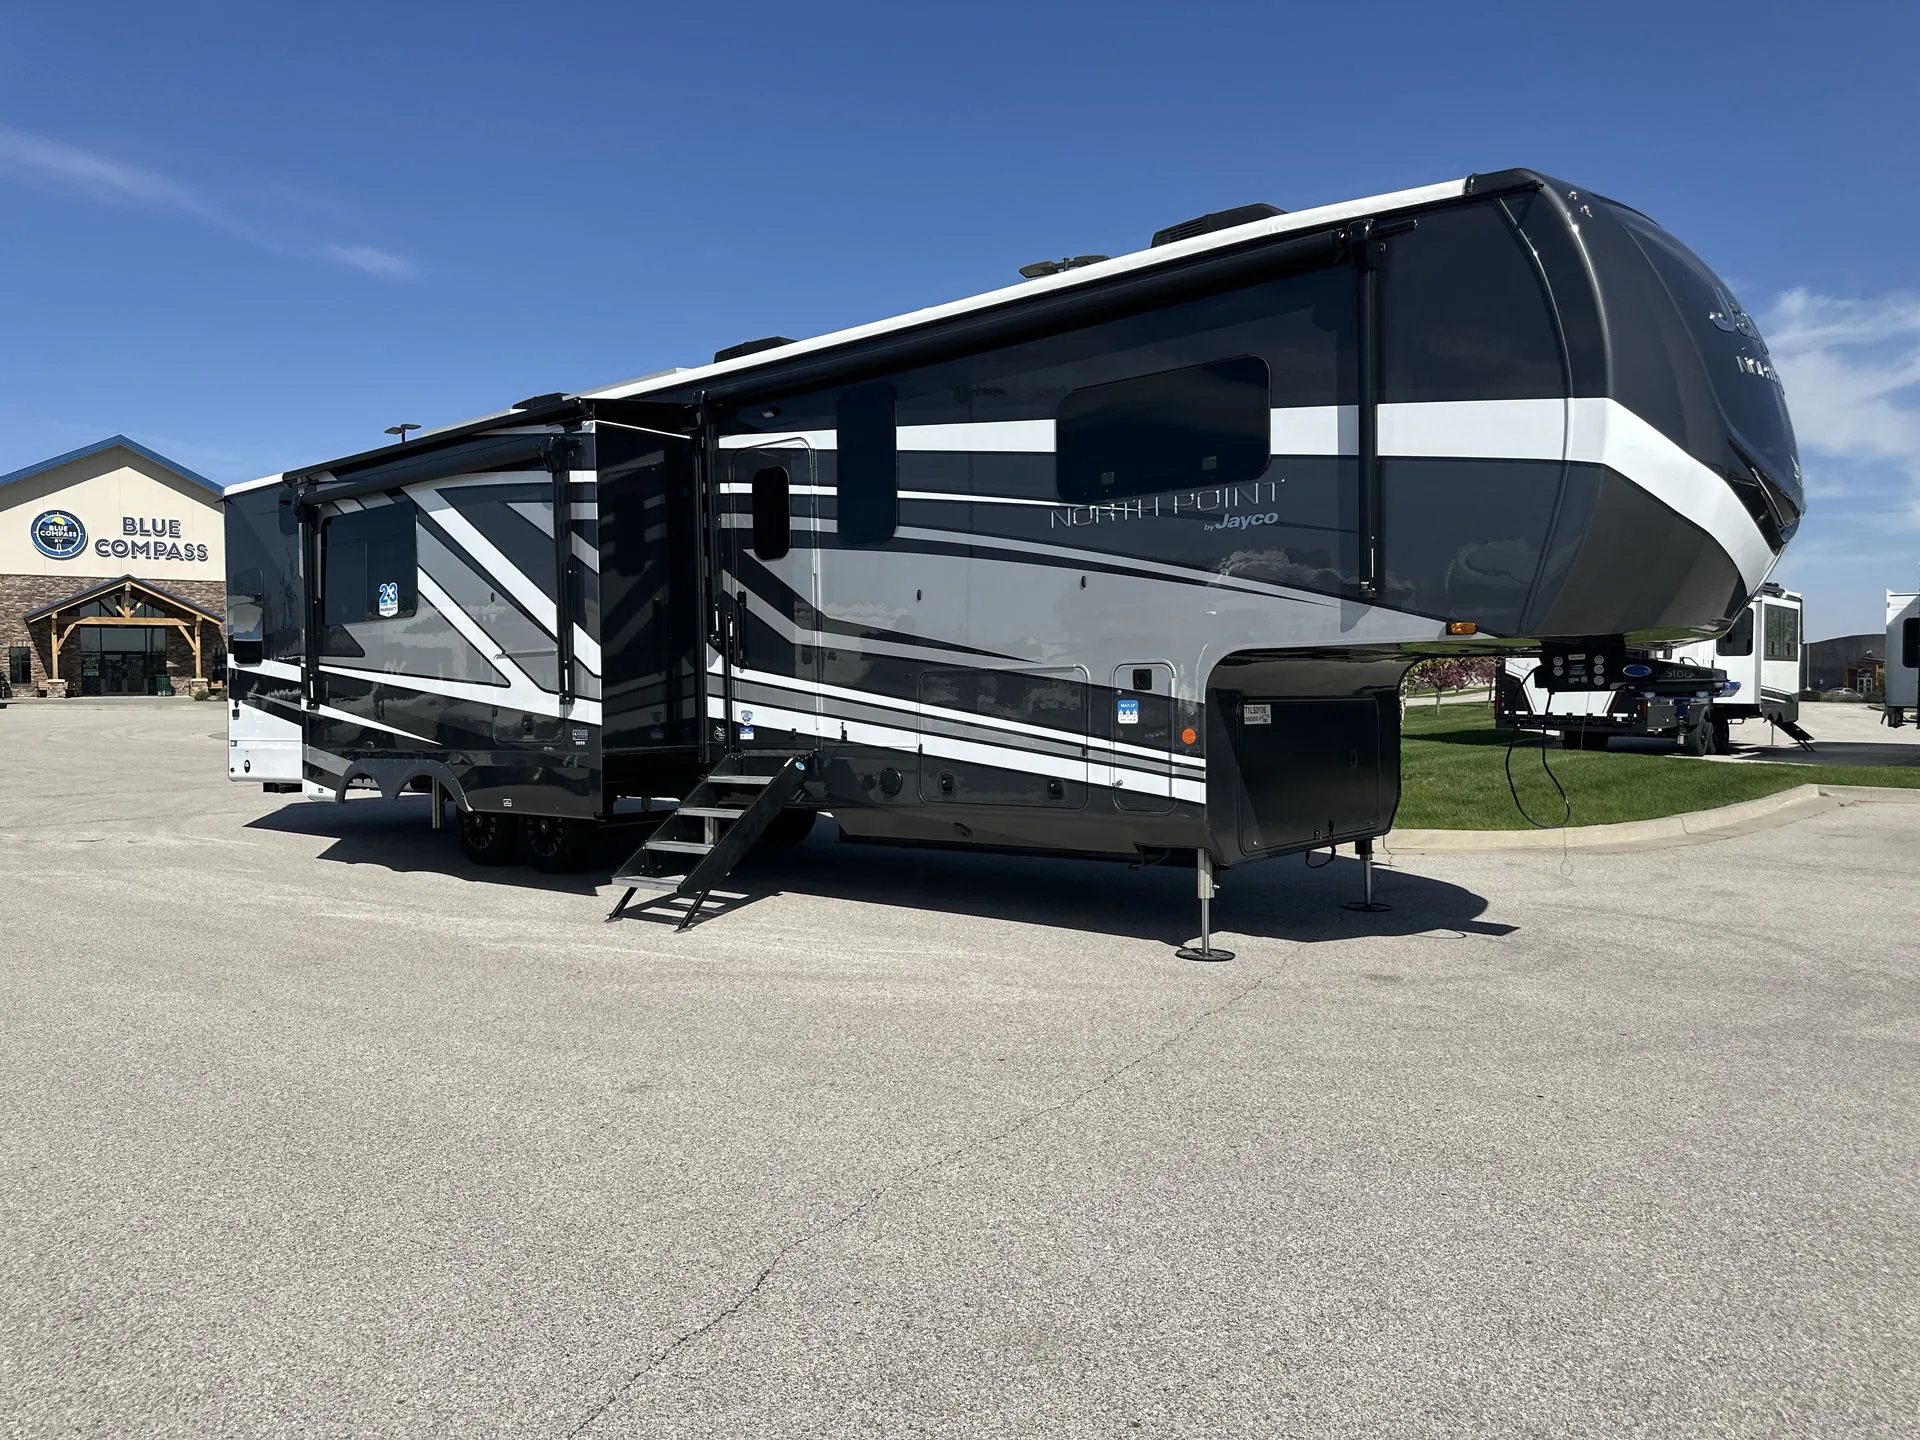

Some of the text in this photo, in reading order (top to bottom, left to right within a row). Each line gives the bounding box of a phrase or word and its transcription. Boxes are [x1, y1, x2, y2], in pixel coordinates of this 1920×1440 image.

[1051, 479, 1285, 529] NORTH POINT
[122, 516, 181, 538] BLUE
[1203, 512, 1279, 532] by Jayco
[94, 538, 209, 562] COMPASS
